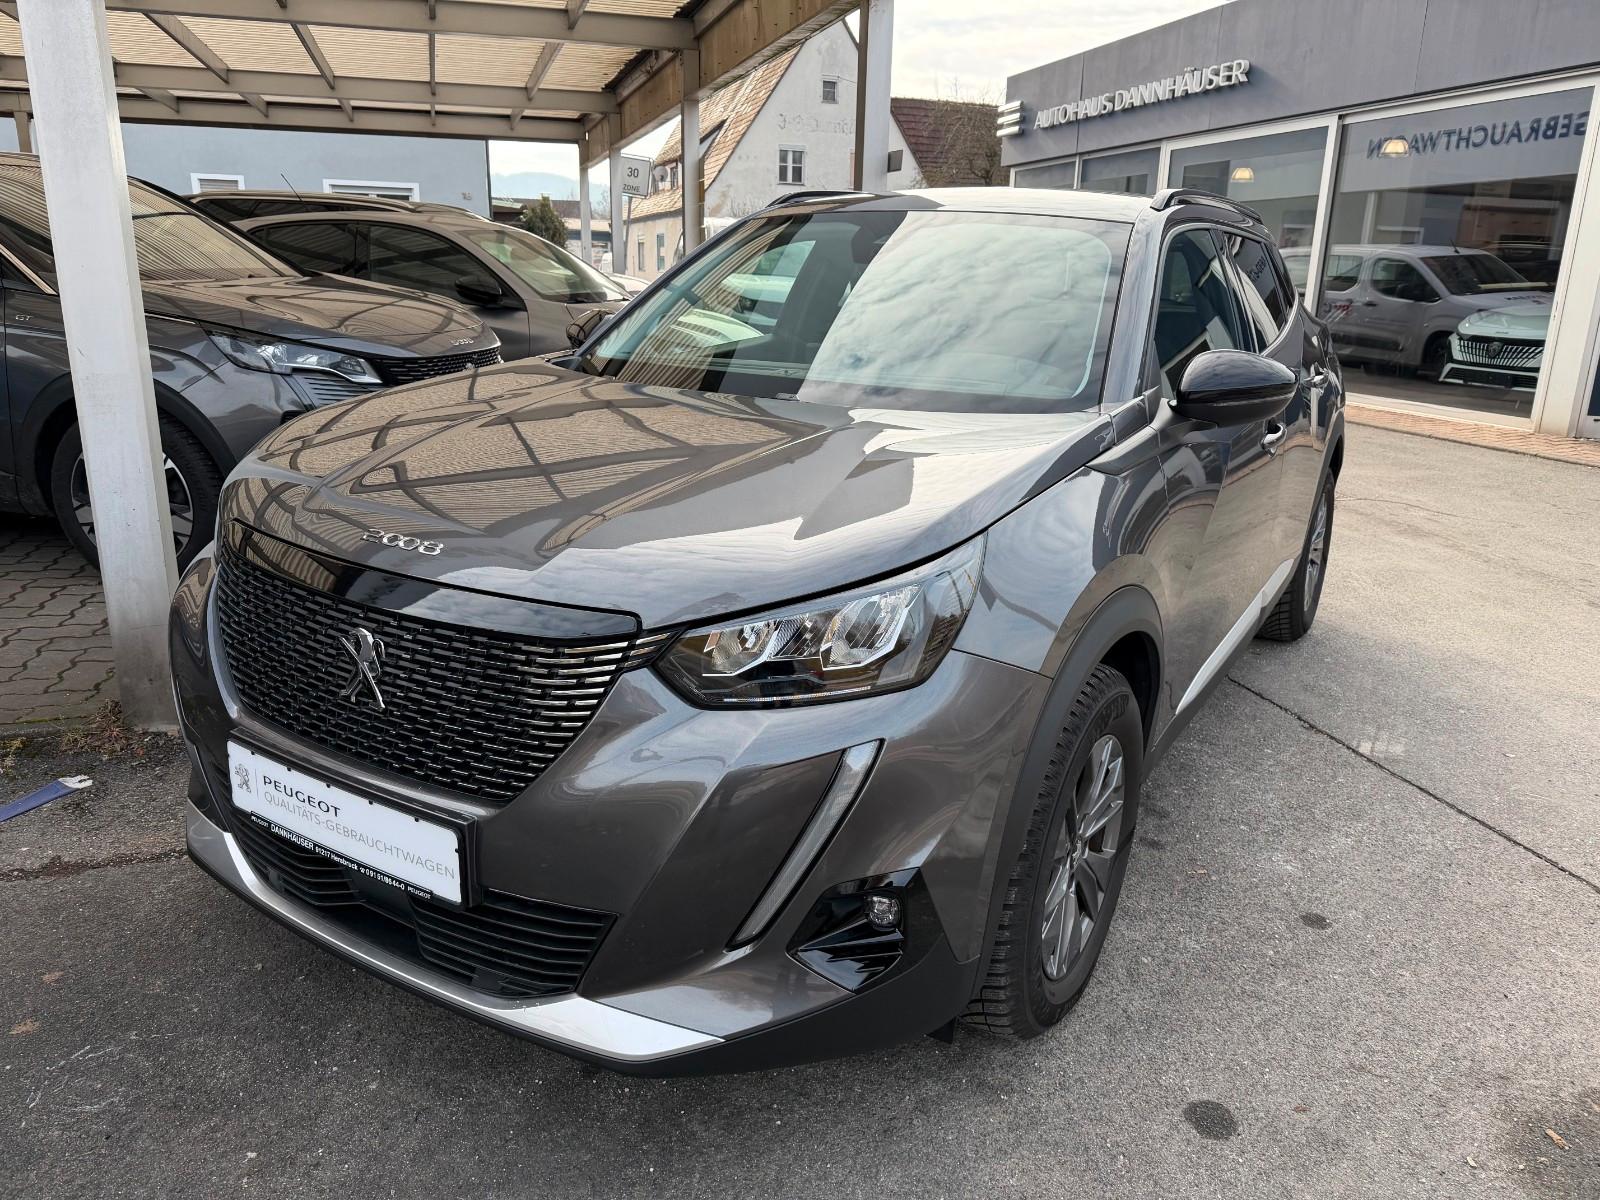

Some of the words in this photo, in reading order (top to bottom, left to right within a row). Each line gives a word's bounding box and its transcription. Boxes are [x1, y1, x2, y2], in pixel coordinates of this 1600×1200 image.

[1033, 91, 1114, 130] AUTOHAUS
[1114, 59, 1250, 112] DANNHÄUSER
[627, 167, 640, 178] 30
[623, 183, 641, 193] ZONE
[362, 528, 444, 556] 2008
[263, 775, 341, 818] PEUGEOT
[264, 791, 455, 880] QUALITÄTS-GEBRAUCHTWAGEN
[407, 885, 432, 900] PEUGEOT
